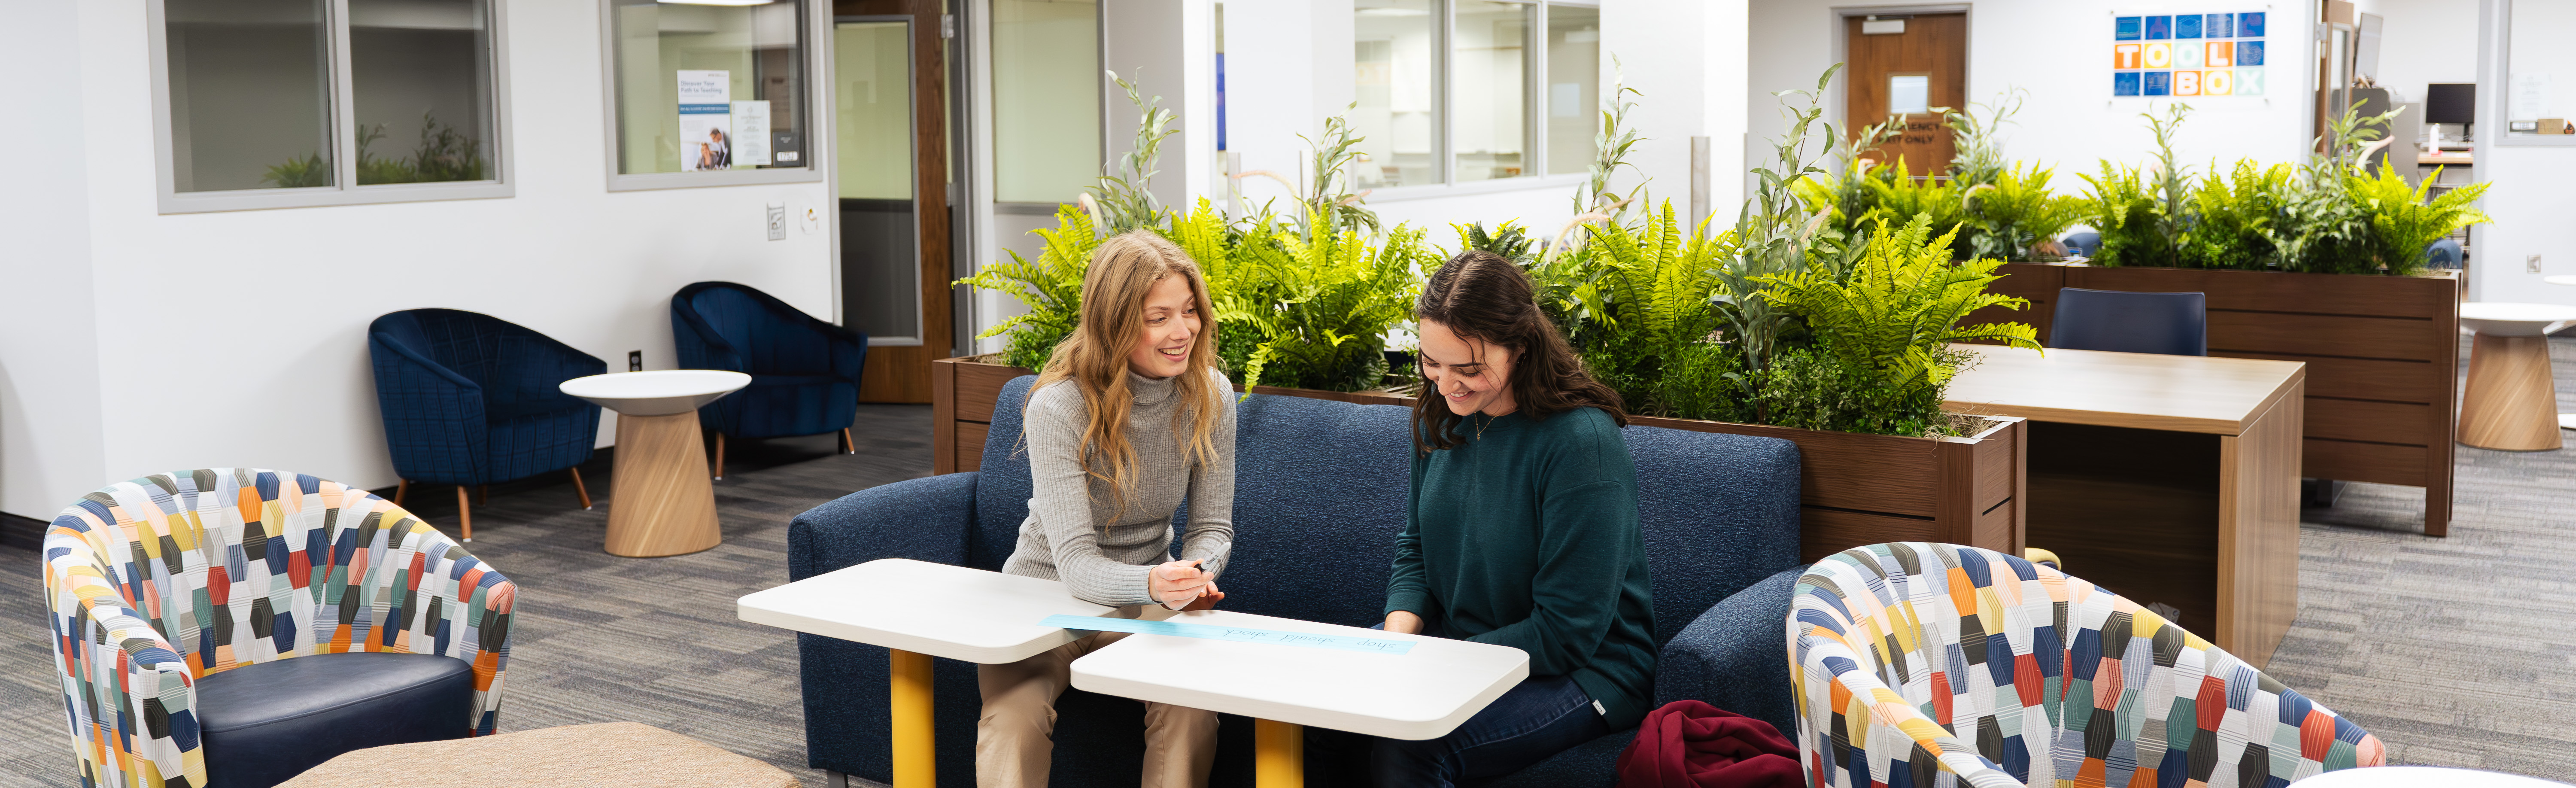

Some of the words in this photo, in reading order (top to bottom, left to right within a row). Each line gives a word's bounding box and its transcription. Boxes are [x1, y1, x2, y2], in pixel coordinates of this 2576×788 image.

[2117, 43, 2229, 68] TOOL
[2176, 70, 2261, 95] BOX
[1905, 135, 1934, 143] ONLY
[1223, 630, 1268, 639] shock
[1279, 635, 1335, 645] should
[1357, 639, 1396, 650] shop
